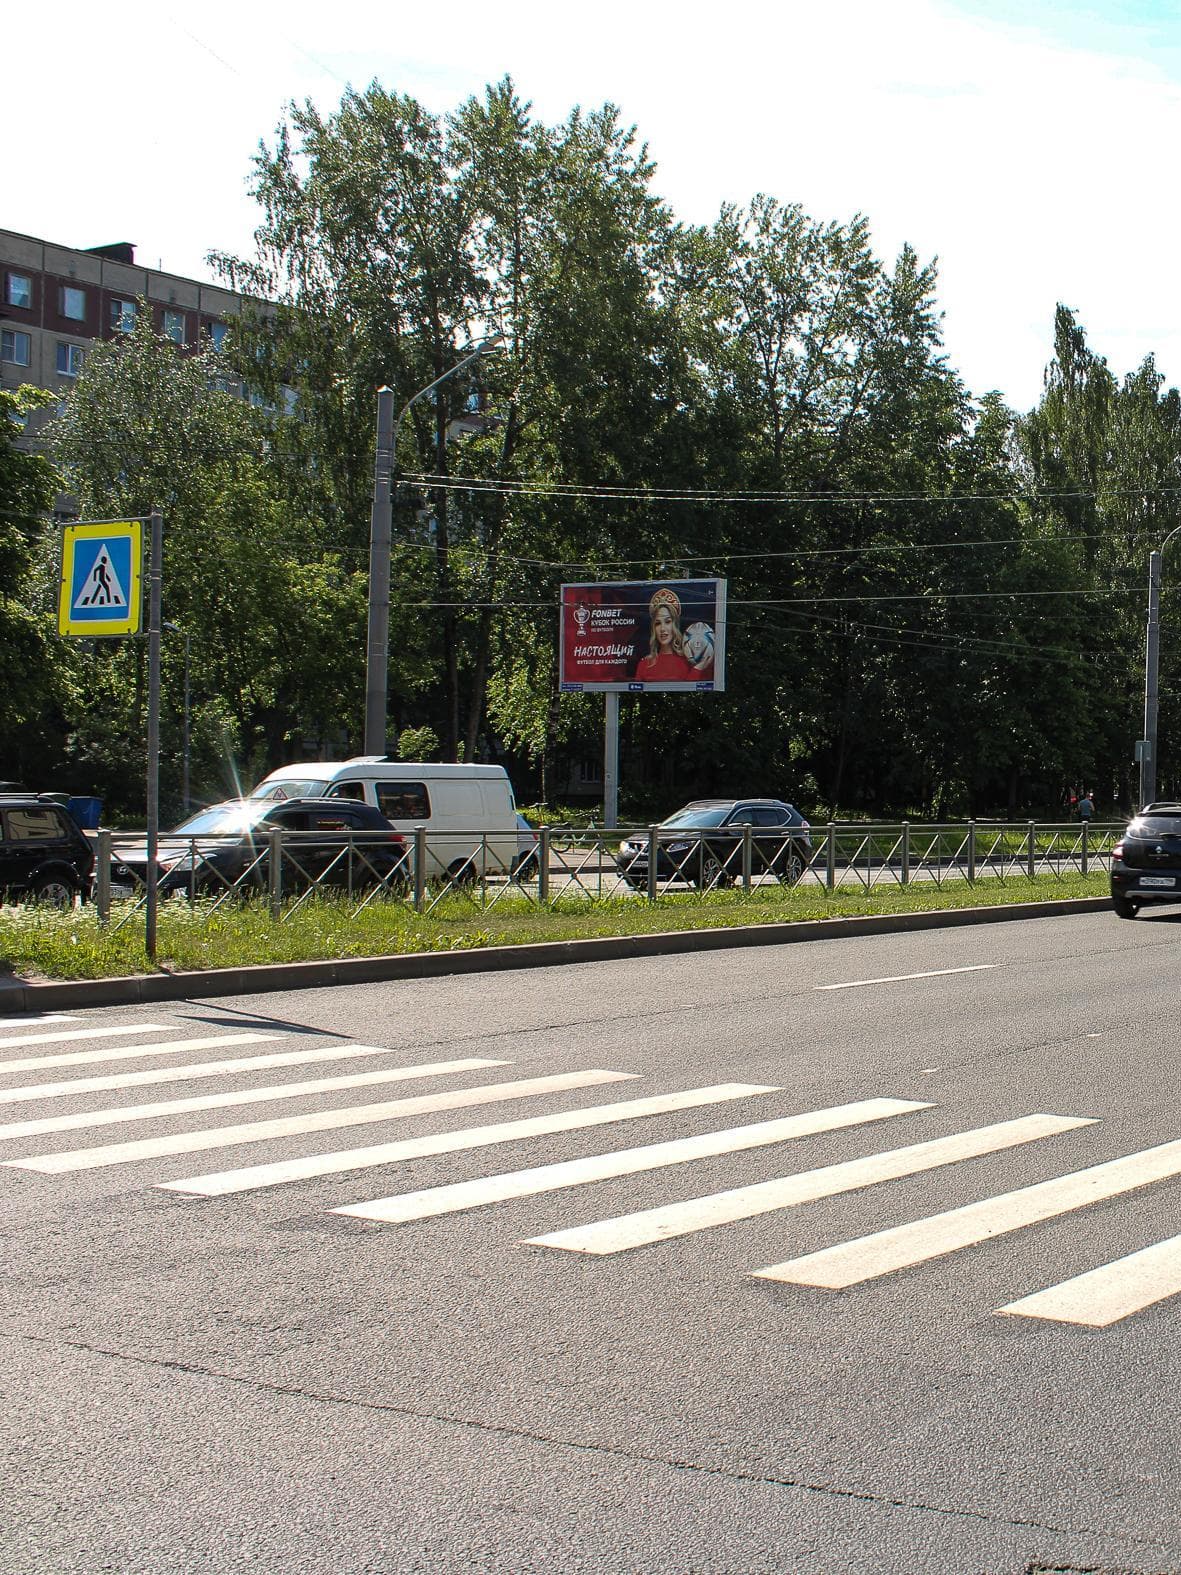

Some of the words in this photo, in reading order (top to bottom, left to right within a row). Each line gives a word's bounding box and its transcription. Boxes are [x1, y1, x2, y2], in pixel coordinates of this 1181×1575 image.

[591, 609, 622, 618] FONBET
[611, 618, 635, 626] РОССИИ
[574, 644, 635, 657] НАСТОЯЩИЙ
